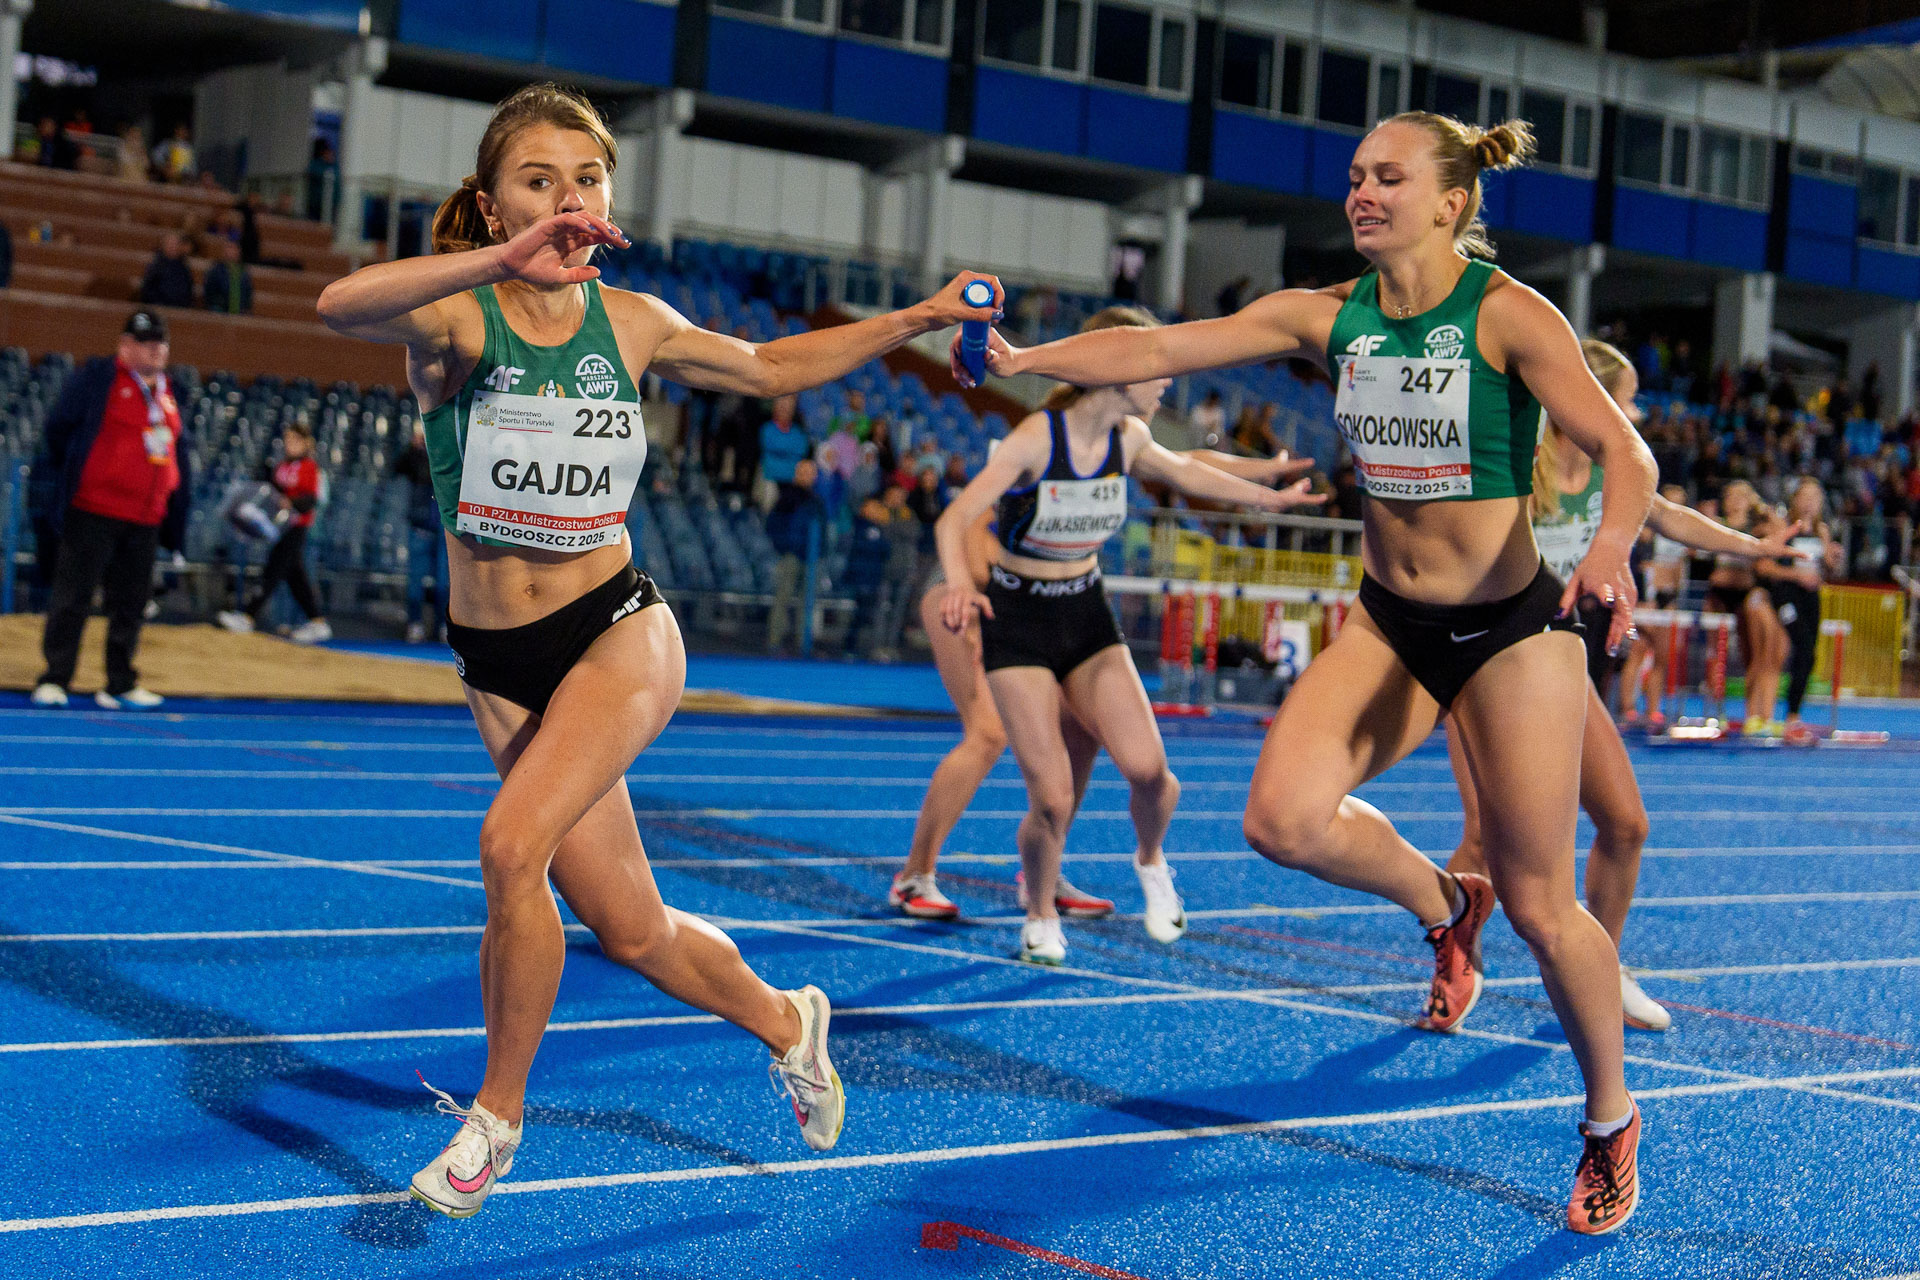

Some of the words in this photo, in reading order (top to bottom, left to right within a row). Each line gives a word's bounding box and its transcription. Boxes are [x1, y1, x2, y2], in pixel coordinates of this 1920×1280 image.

[1346, 334, 1387, 356] 4F
[1434, 331, 1456, 342] AZS
[1432, 347, 1457, 358] AWF
[584, 362, 607, 375] AZS
[484, 365, 526, 392] 4F
[586, 381, 614, 394] AWF
[1400, 366, 1455, 394] 247
[498, 416, 520, 424] Sportu
[525, 418, 555, 427] Turystyki
[500, 408, 541, 418] Ministerstwo
[574, 408, 632, 439] 223
[1337, 412, 1462, 448] SOKOŁOWSKA
[491, 459, 611, 497] GAJDA
[1370, 466, 1426, 478] Mistrzostwa
[1428, 465, 1462, 477] Polski
[1368, 481, 1412, 494] GOSZCZ
[1414, 481, 1450, 494] 2025
[468, 504, 488, 516] 101.
[491, 509, 519, 522] PZLA
[522, 514, 592, 529] Mistrzostwa
[593, 514, 618, 528] Polski
[480, 521, 575, 547] BYDGOSZCZ
[578, 531, 605, 547] 2025
[1030, 577, 1087, 596] NIKE
